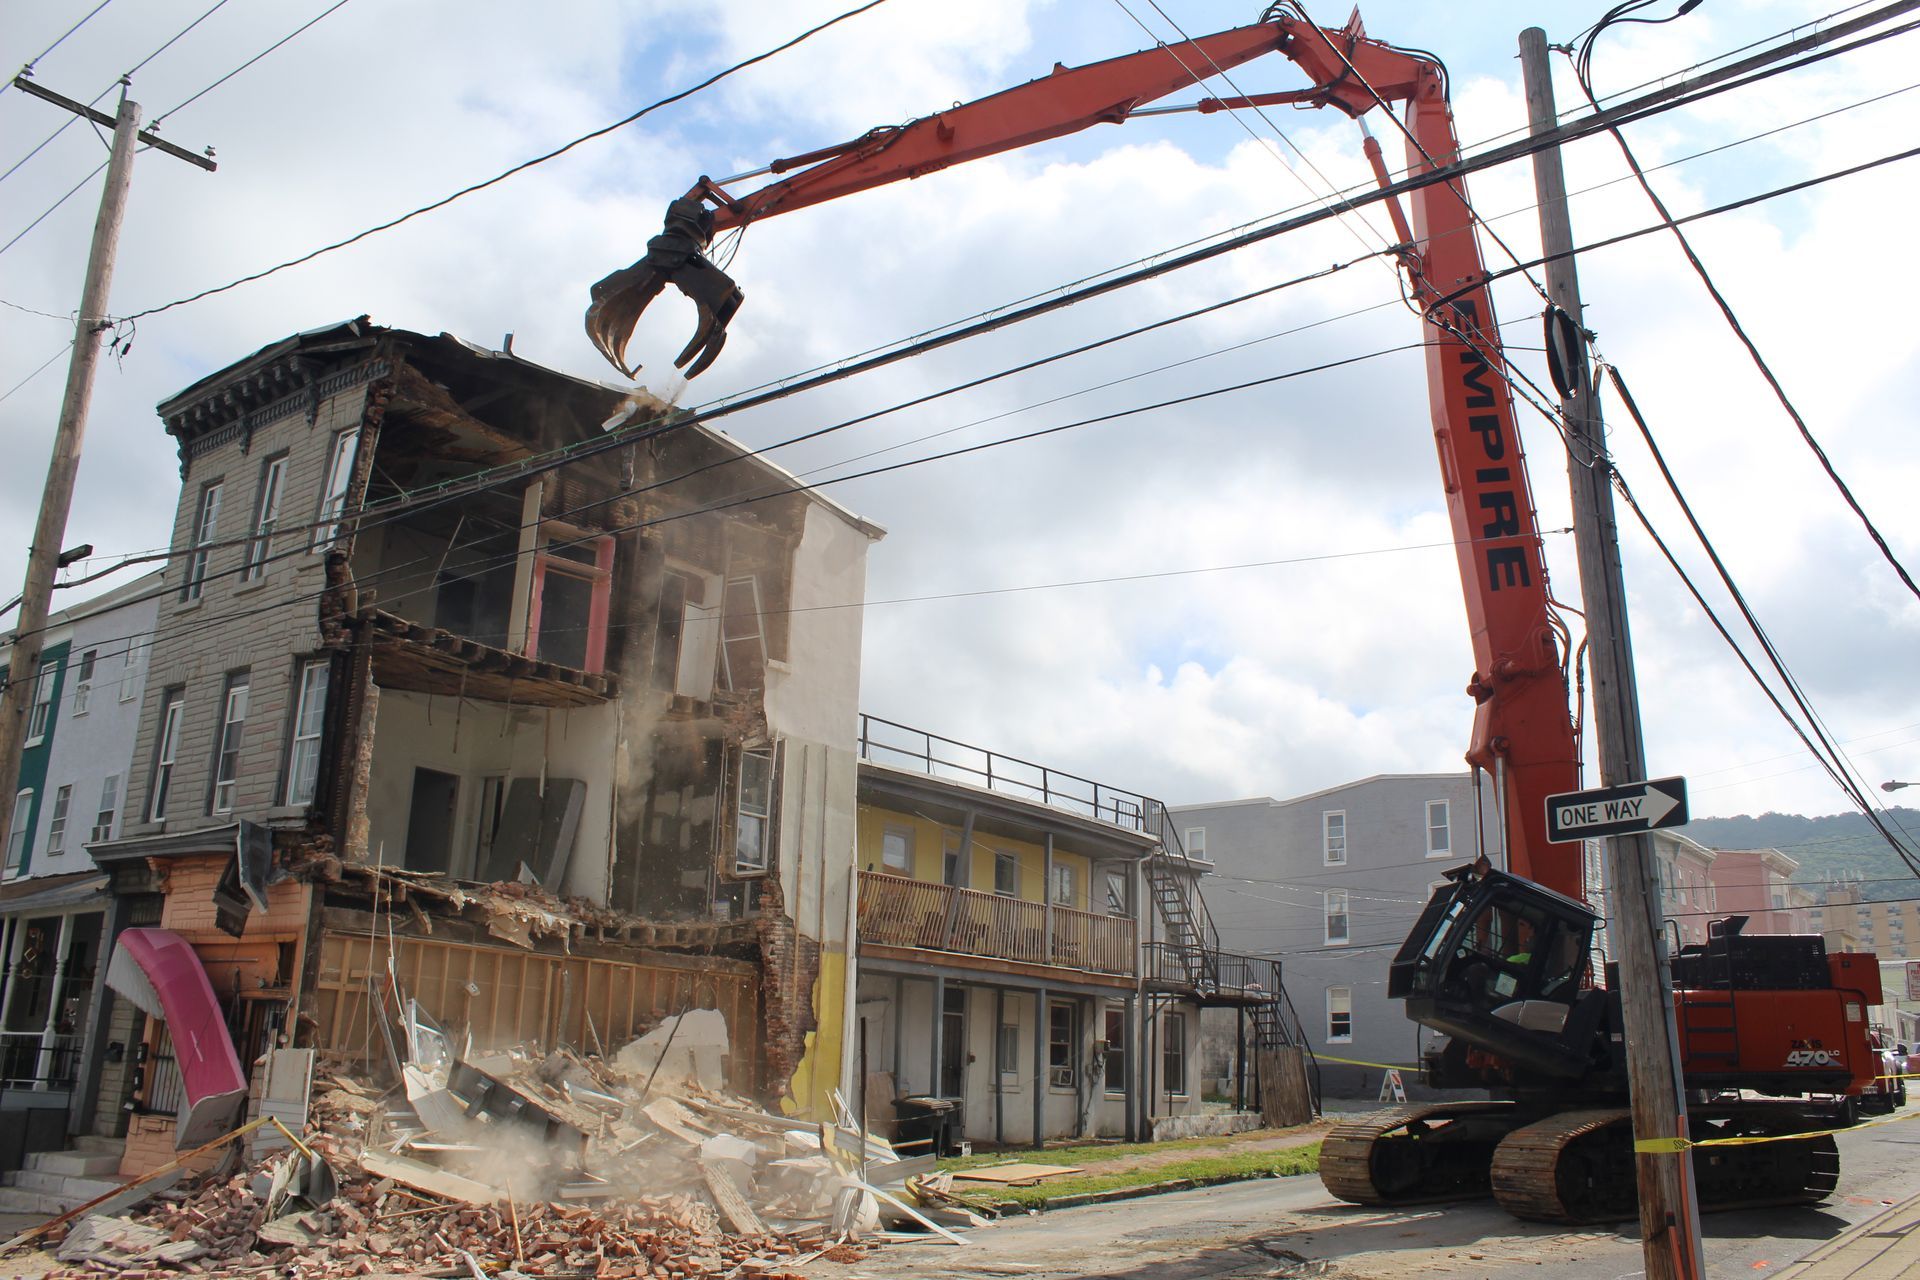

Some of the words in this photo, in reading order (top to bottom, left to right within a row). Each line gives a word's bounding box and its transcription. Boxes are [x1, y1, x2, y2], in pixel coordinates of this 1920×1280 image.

[1453, 300, 1530, 592] EMPIRE
[1561, 805, 1598, 827] ONE
[1604, 798, 1643, 821] WAY
